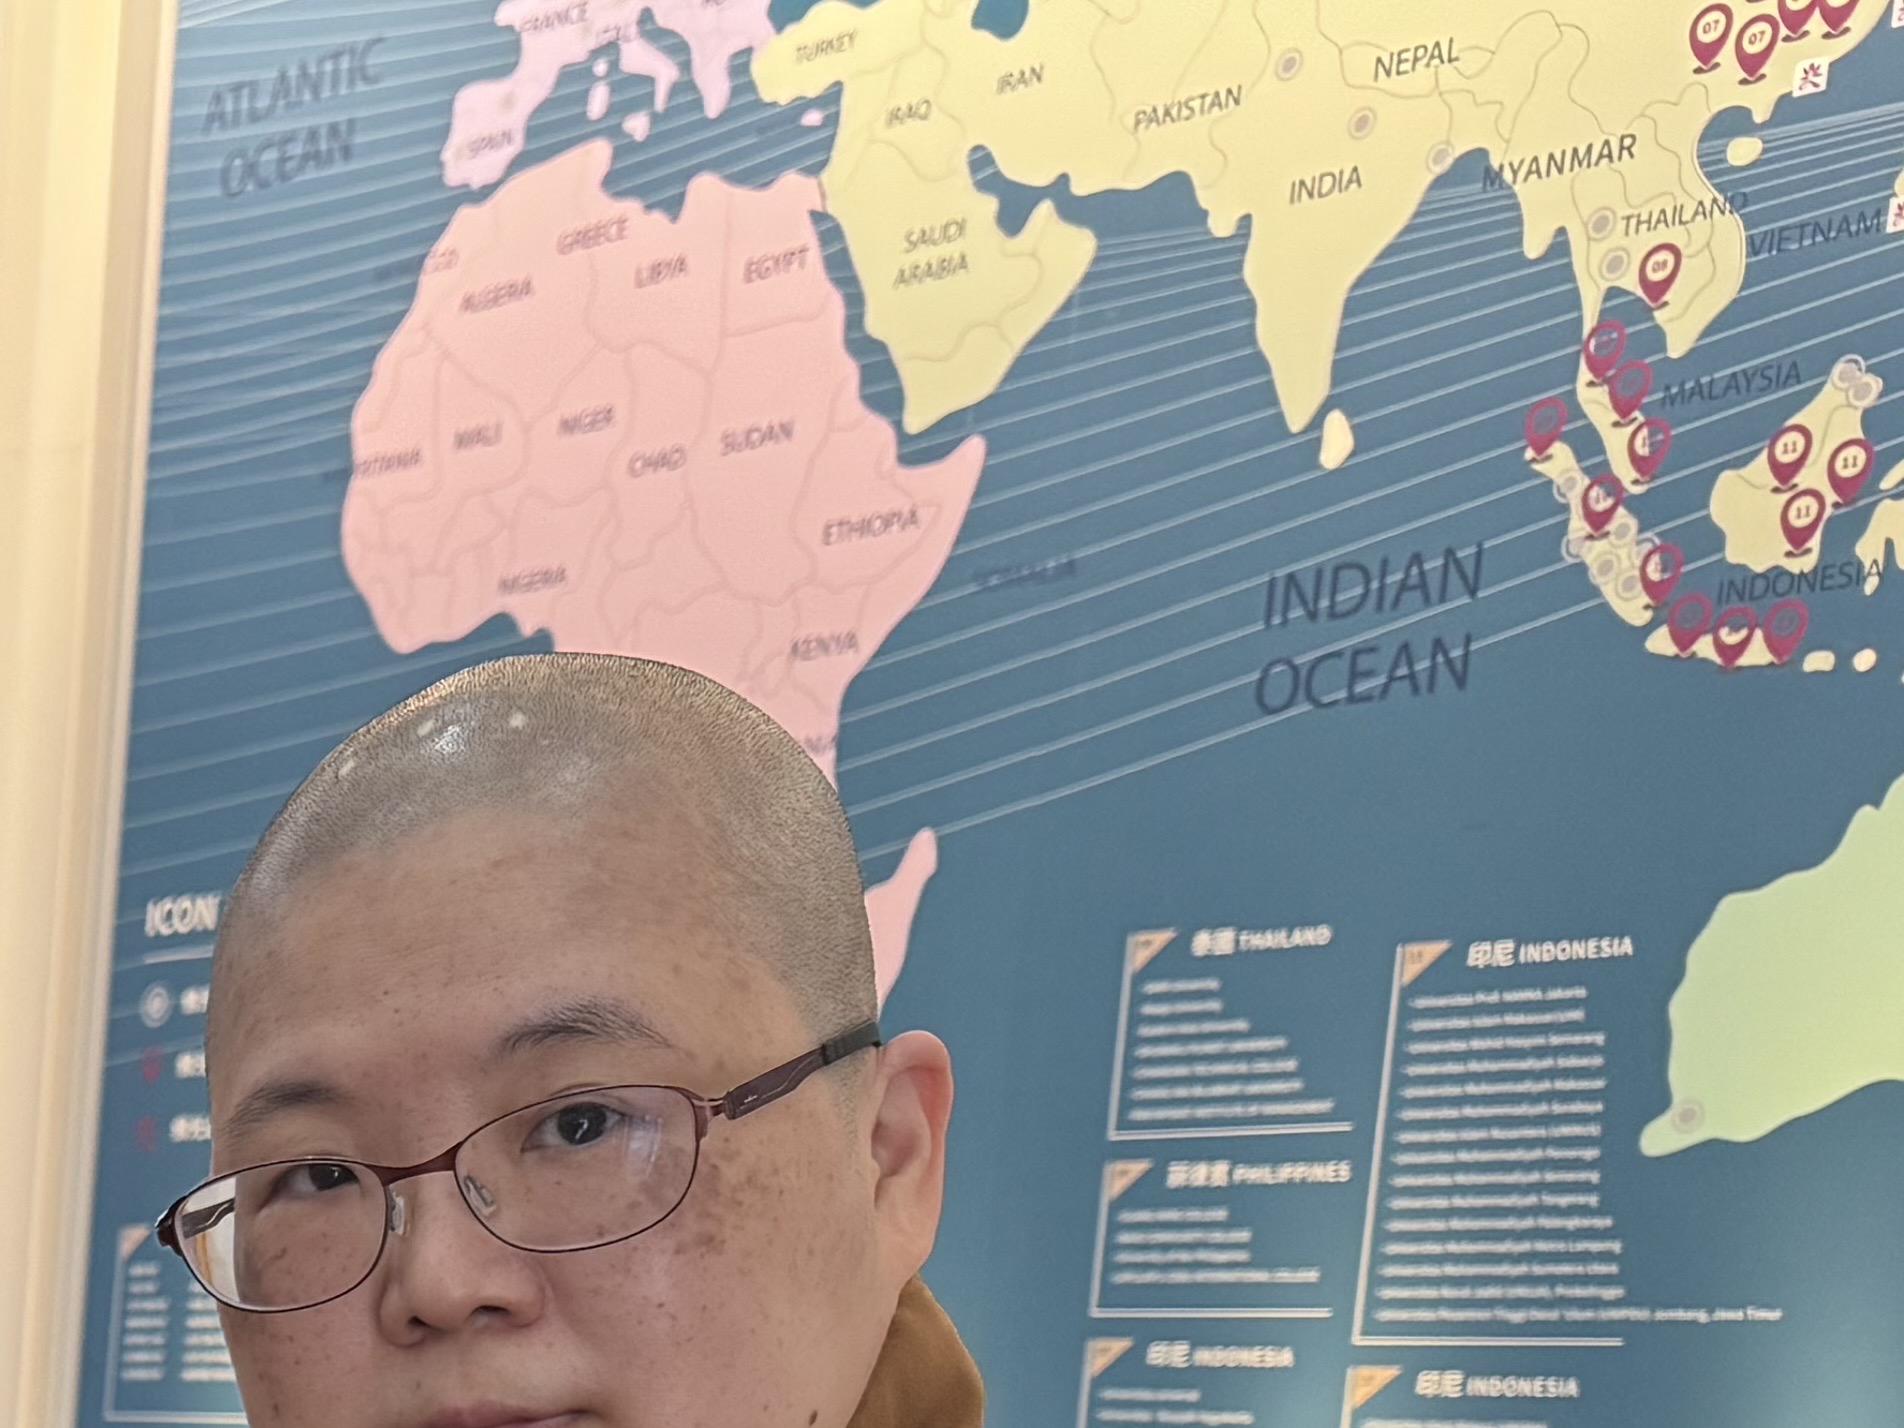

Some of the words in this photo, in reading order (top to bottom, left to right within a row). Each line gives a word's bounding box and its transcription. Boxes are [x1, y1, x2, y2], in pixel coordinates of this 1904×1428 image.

[1702, 19, 1721, 35] 07
[1747, 29, 1767, 46] 07
[794, 30, 859, 64] TURKEY
[1371, 36, 1461, 83] NEPAL
[200, 36, 388, 137] ATLANTIC
[995, 63, 1045, 95] IRAN
[885, 99, 933, 129] IRAQ
[1131, 84, 1243, 131] PAKISTAN
[219, 118, 358, 198] OCEAN
[465, 127, 514, 160] SPAIN
[1480, 132, 1638, 192] MYANMAR
[1288, 165, 1363, 206] INDIA
[1621, 190, 1749, 238] THAILAND
[1747, 207, 1885, 258] VIETNAM
[555, 214, 629, 256] GREECE
[903, 217, 968, 254] SAUDI
[634, 254, 689, 290] LIBYA
[743, 243, 811, 285] EGYPT
[892, 253, 970, 290] ARABIA
[1660, 360, 1803, 410] MALAYSIA
[720, 420, 796, 457] SUDAN
[626, 443, 688, 479] CHAD
[821, 503, 921, 547] ETHIOPIA
[1263, 542, 1485, 630] INDIAN
[1716, 557, 1885, 608] INDONESIA
[788, 628, 860, 662] KENYA
[1254, 631, 1474, 716] OCEAN
[1238, 923, 1334, 951] THAILAND
[1518, 935, 1634, 965] INDONESIA
[1232, 1159, 1352, 1186] PHILIPPINES
[1192, 1344, 1294, 1370] INDONESIA
[1467, 1374, 1580, 1399] INDONESIA
